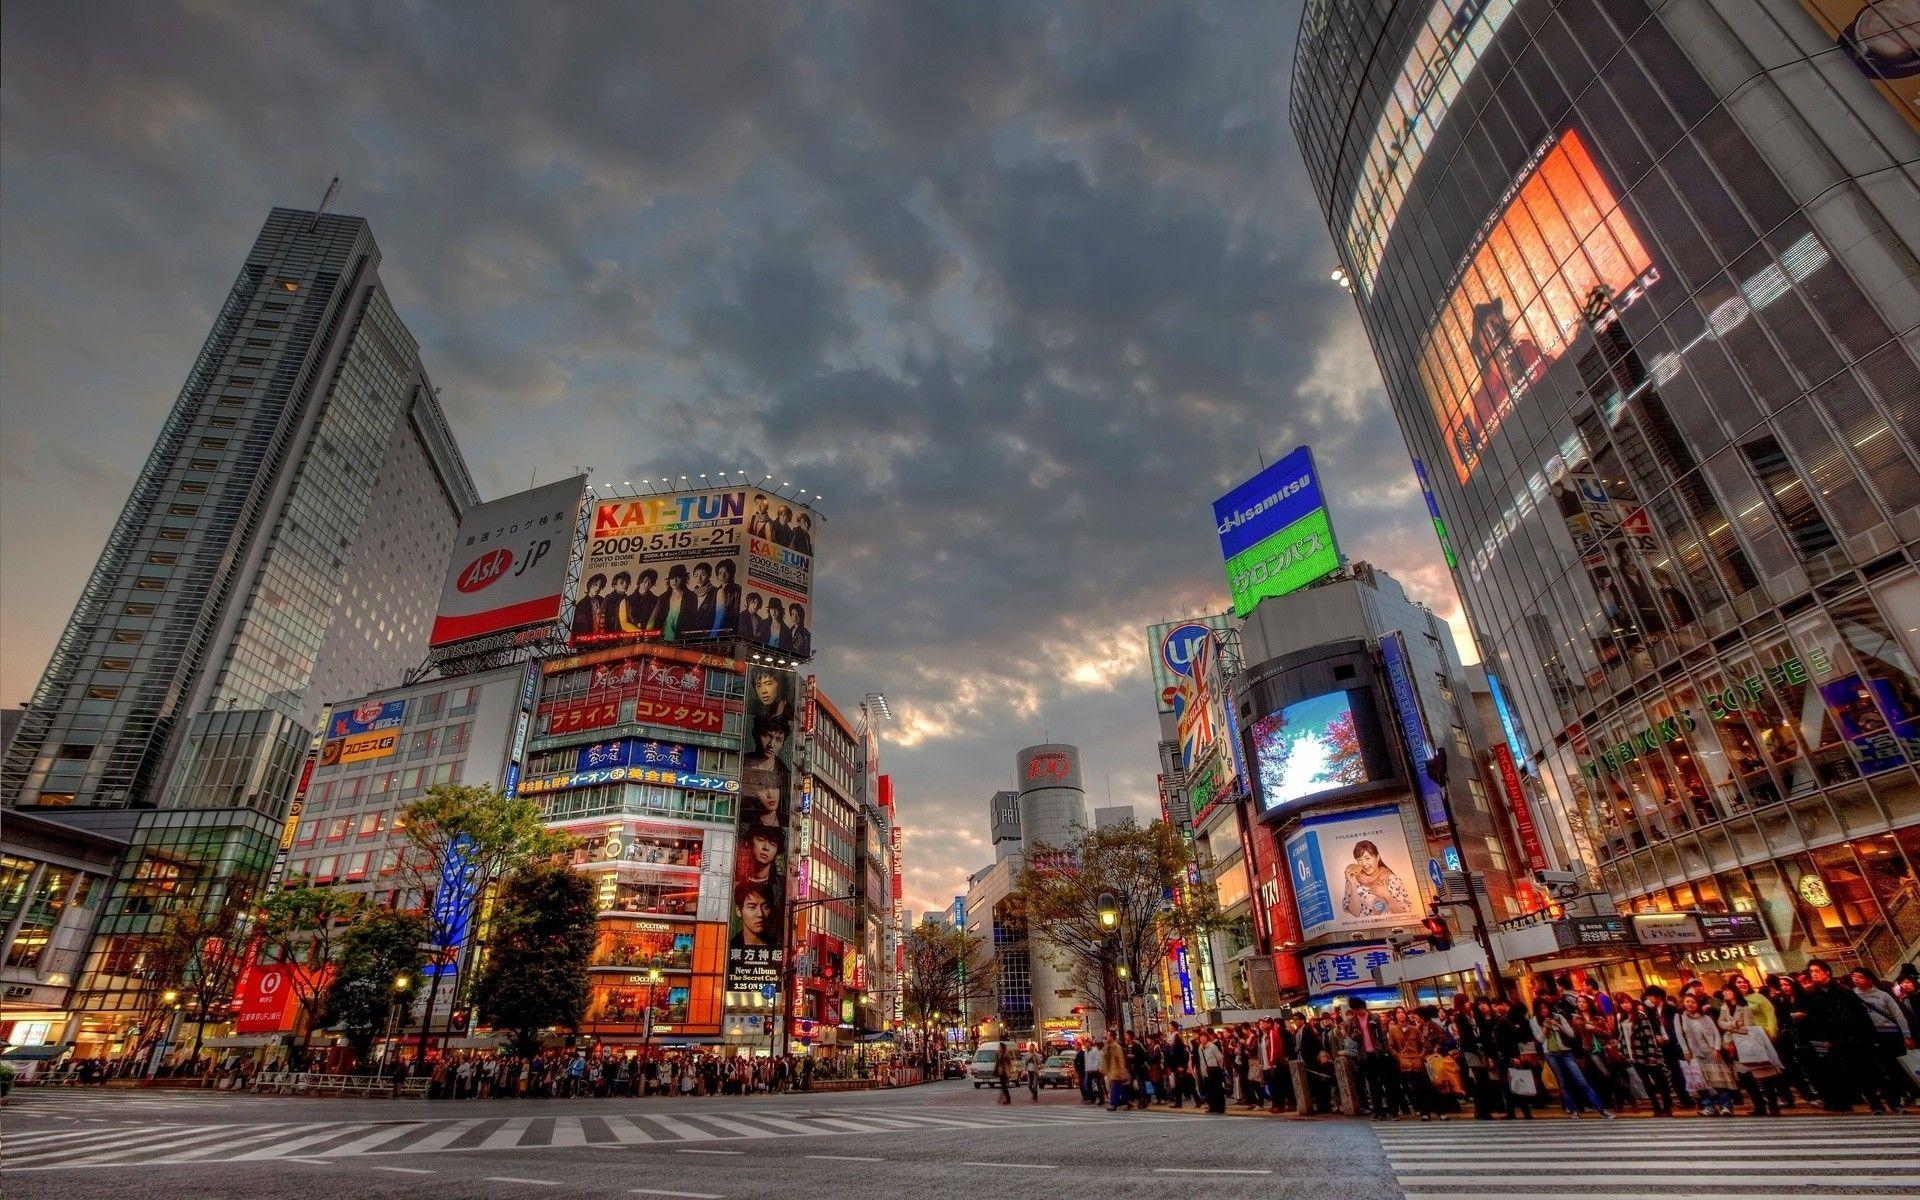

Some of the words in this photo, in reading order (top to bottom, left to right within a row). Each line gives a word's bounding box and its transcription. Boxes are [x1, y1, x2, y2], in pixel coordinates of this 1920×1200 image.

[596, 492, 745, 530] KAT-TUN
[1218, 474, 1310, 534] Hisamitsu
[590, 556, 612, 564] TOKYO
[750, 538, 809, 569] KAT-TUN
[1234, 532, 1323, 593] サロンパス
[1708, 647, 1832, 720] COFFEE
[552, 704, 617, 729] プライス
[638, 701, 720, 726] コンタクト
[343, 740, 379, 756] プロミス
[380, 737, 392, 748] 4F
[1007, 794, 1020, 805] TH
[1519, 822, 1544, 869] 三千里
[636, 922, 670, 930] L'OCCITANE
[730, 948, 783, 961] 東方神起
[735, 967, 752, 975] New
[752, 967, 777, 975] Album
